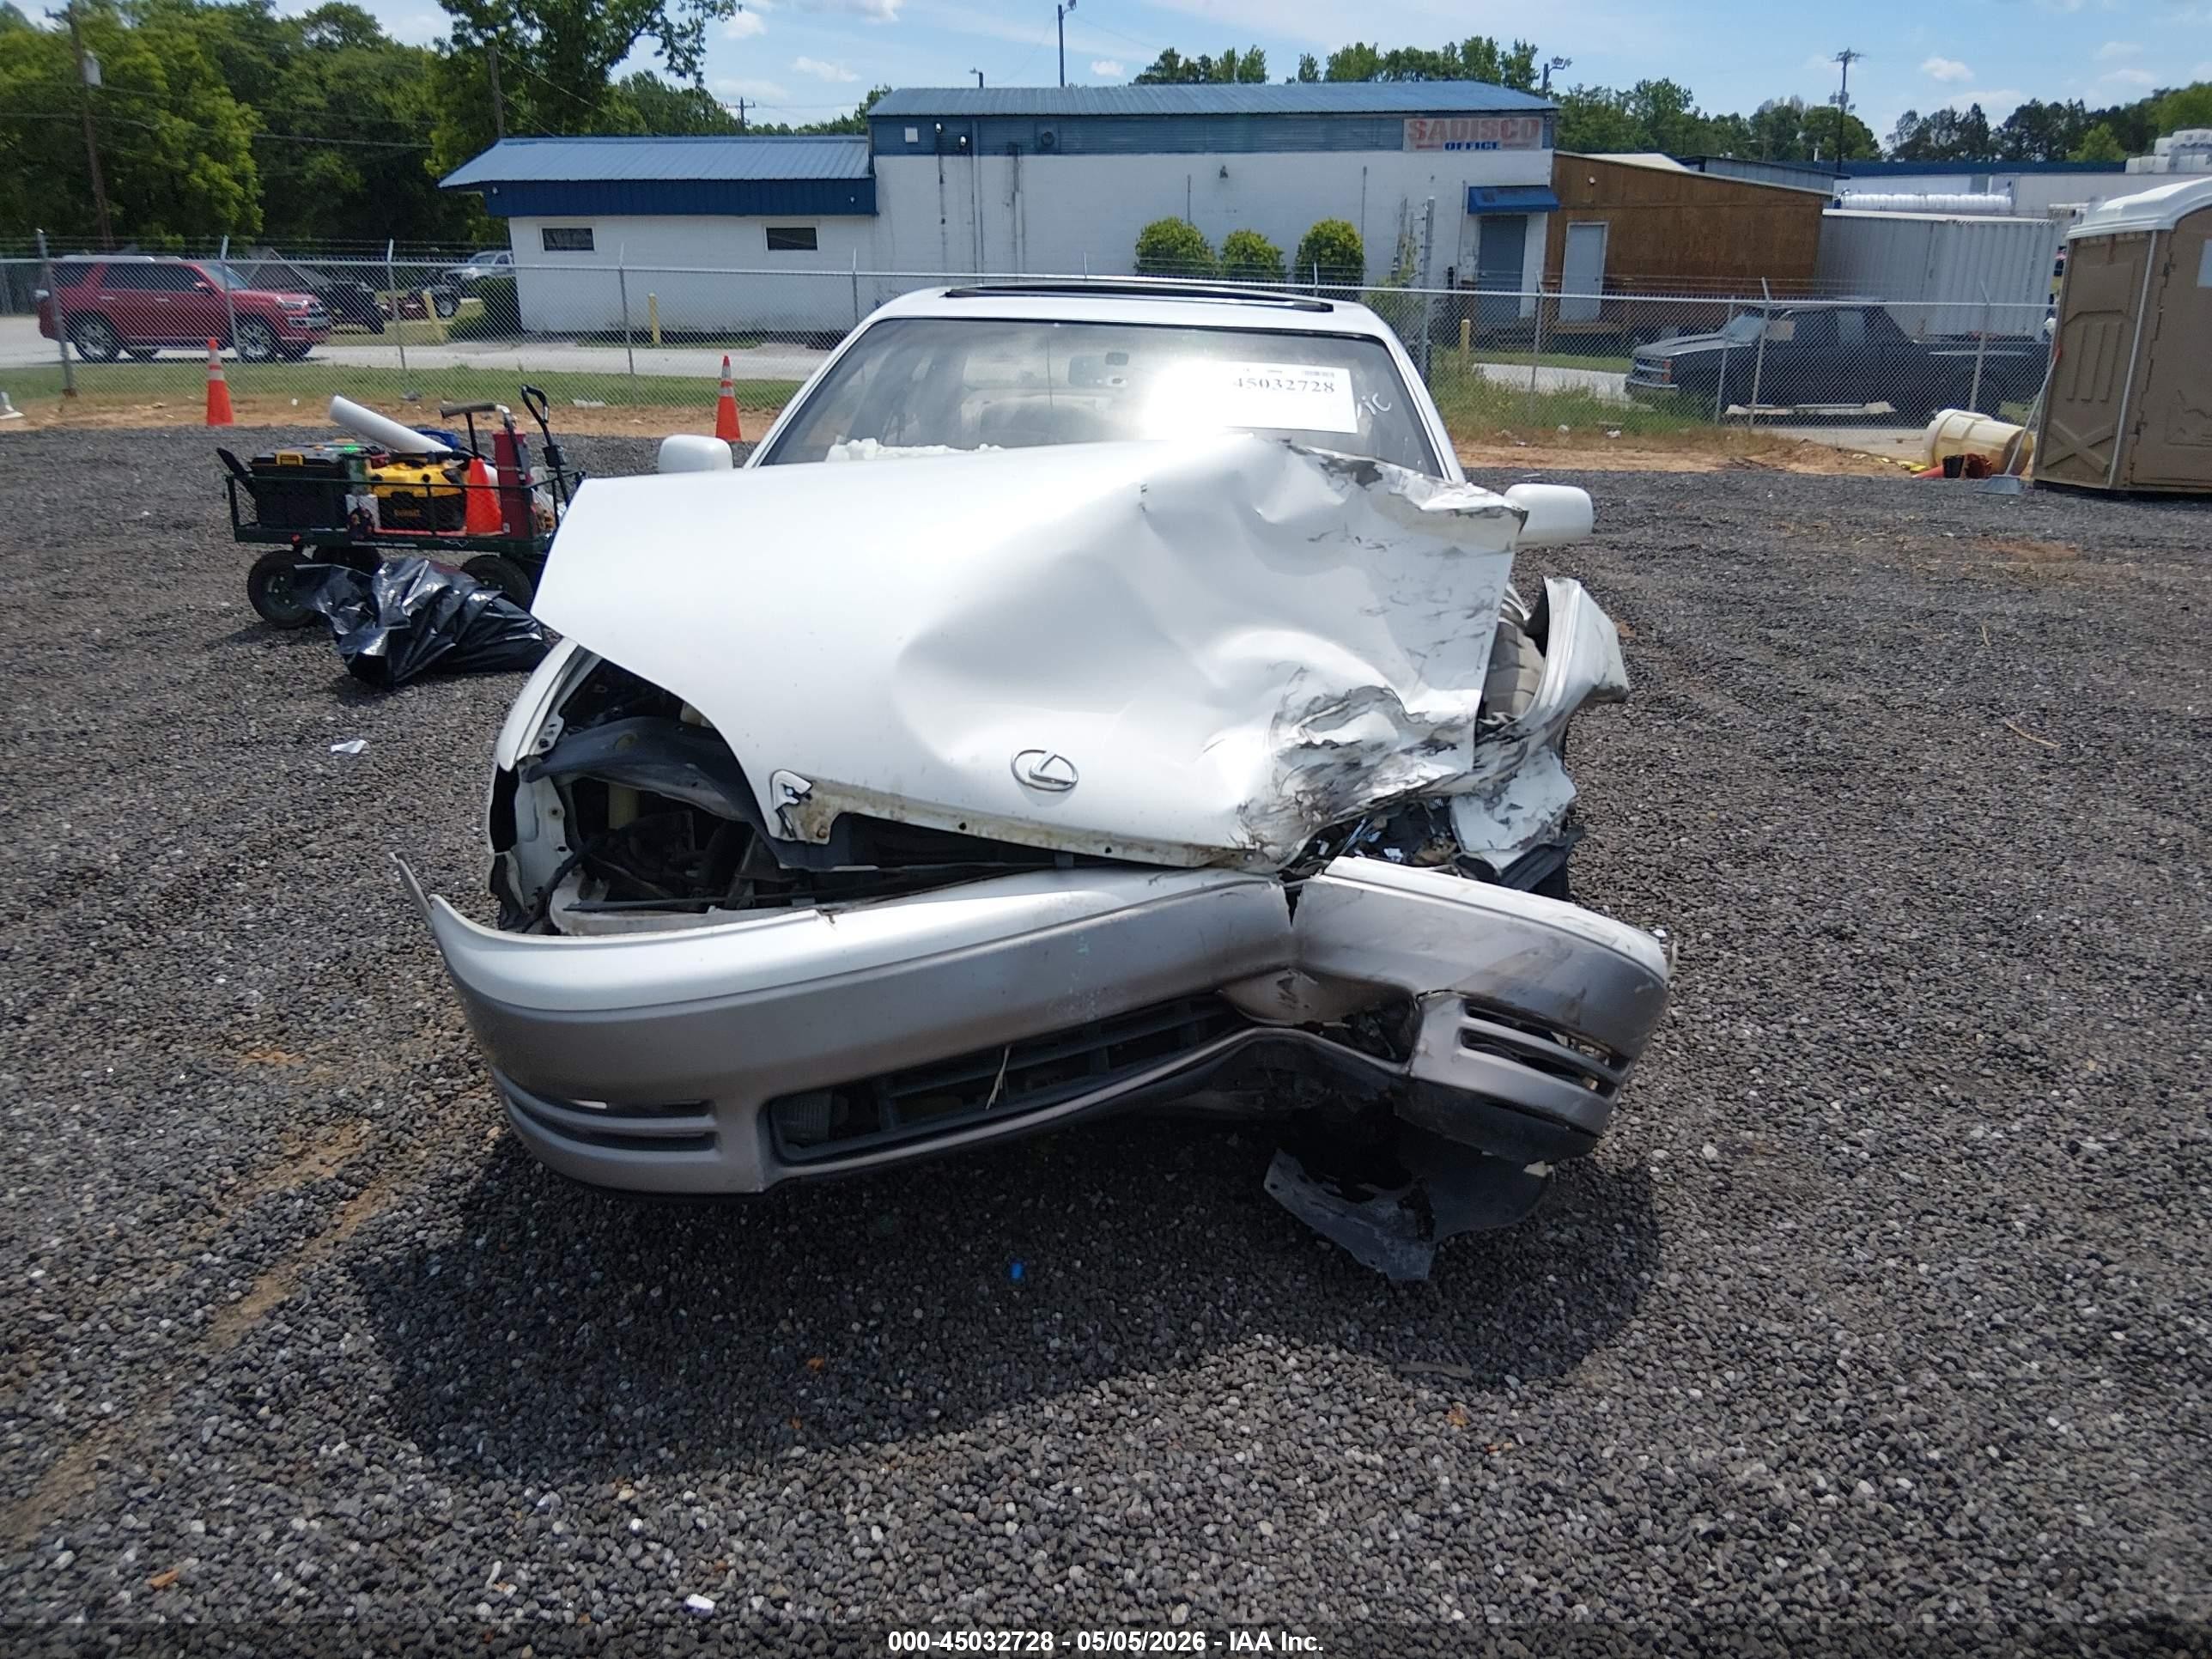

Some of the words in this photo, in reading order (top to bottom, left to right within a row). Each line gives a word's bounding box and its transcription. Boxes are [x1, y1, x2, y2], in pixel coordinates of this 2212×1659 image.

[1408, 118, 1540, 140] SADISCO
[1444, 141, 1501, 151] OFFICE
[1234, 377, 1335, 393] 45032728
